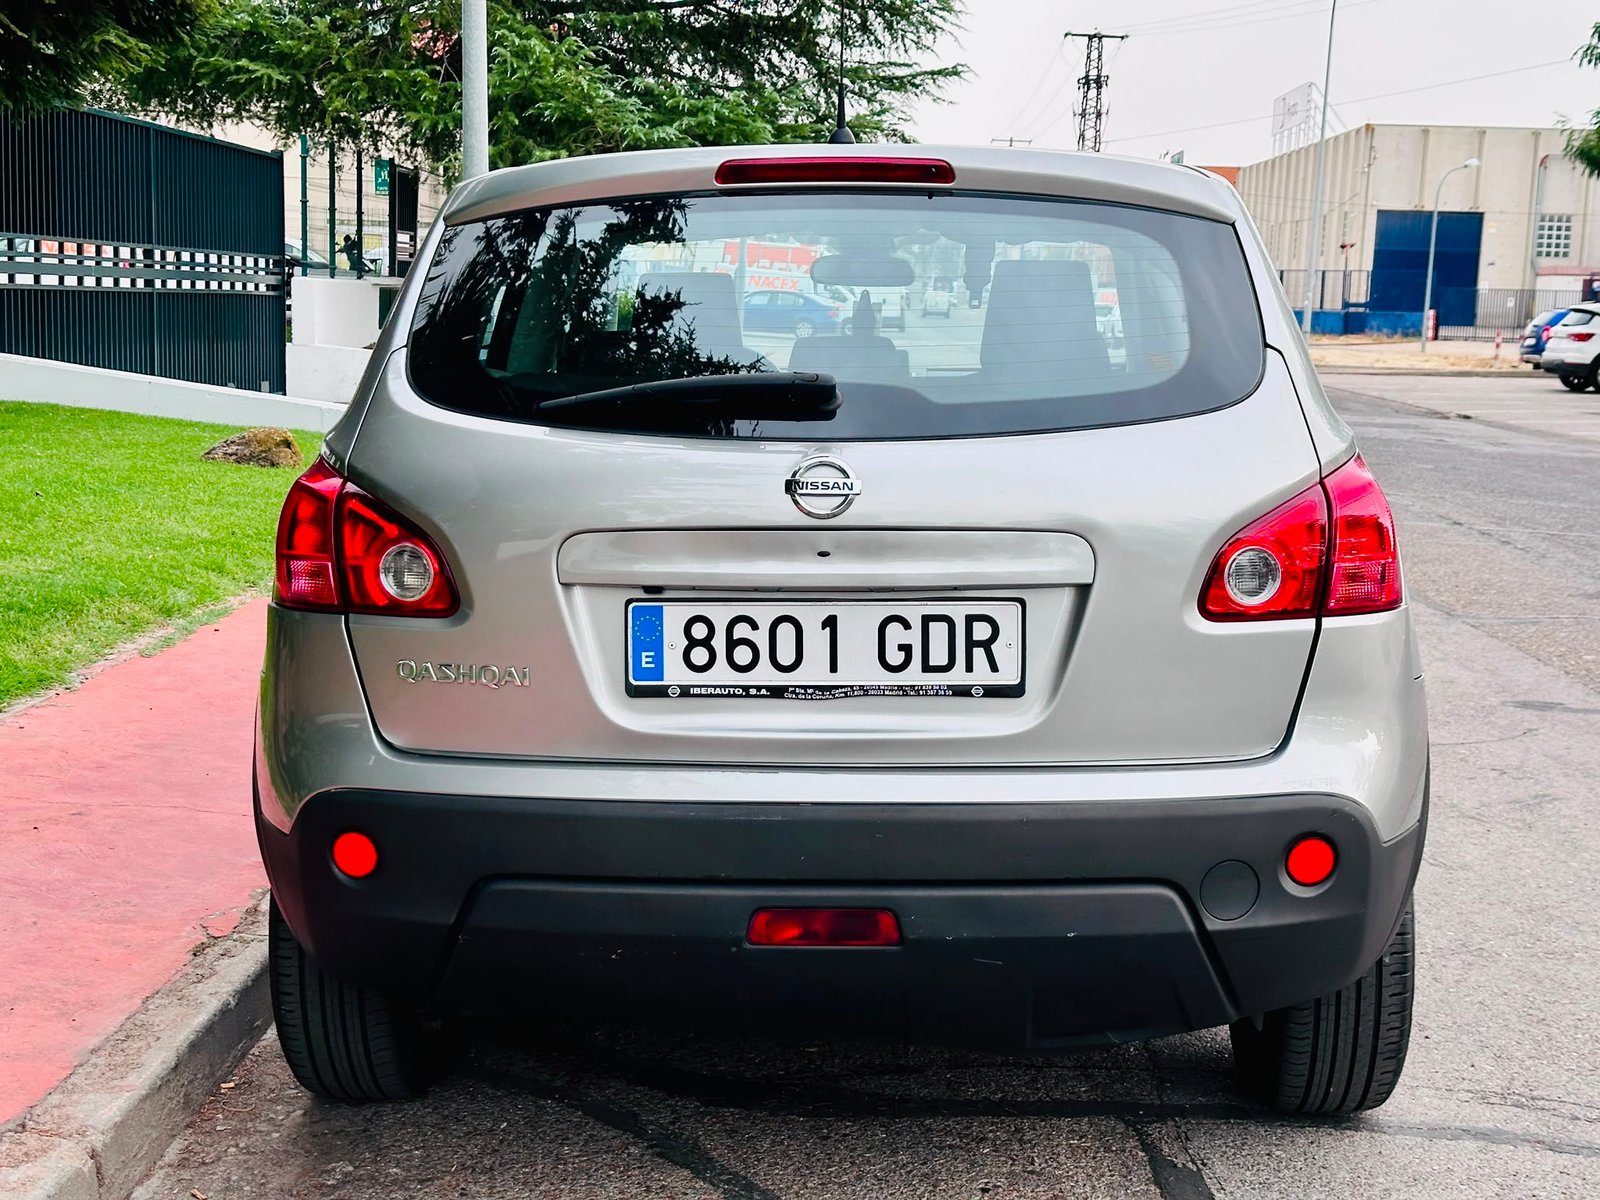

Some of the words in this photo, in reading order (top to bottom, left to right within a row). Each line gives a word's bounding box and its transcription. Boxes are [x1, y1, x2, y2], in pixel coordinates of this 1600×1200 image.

[748, 275, 799, 290] NACEX
[793, 480, 853, 491] NISSAN
[682, 613, 839, 674] 8601
[877, 613, 1000, 674] GDR
[641, 651, 655, 667] E
[396, 658, 531, 689] QASHQAI
[690, 687, 746, 696] IBERAUTO,
[748, 688, 770, 696] S.A.
